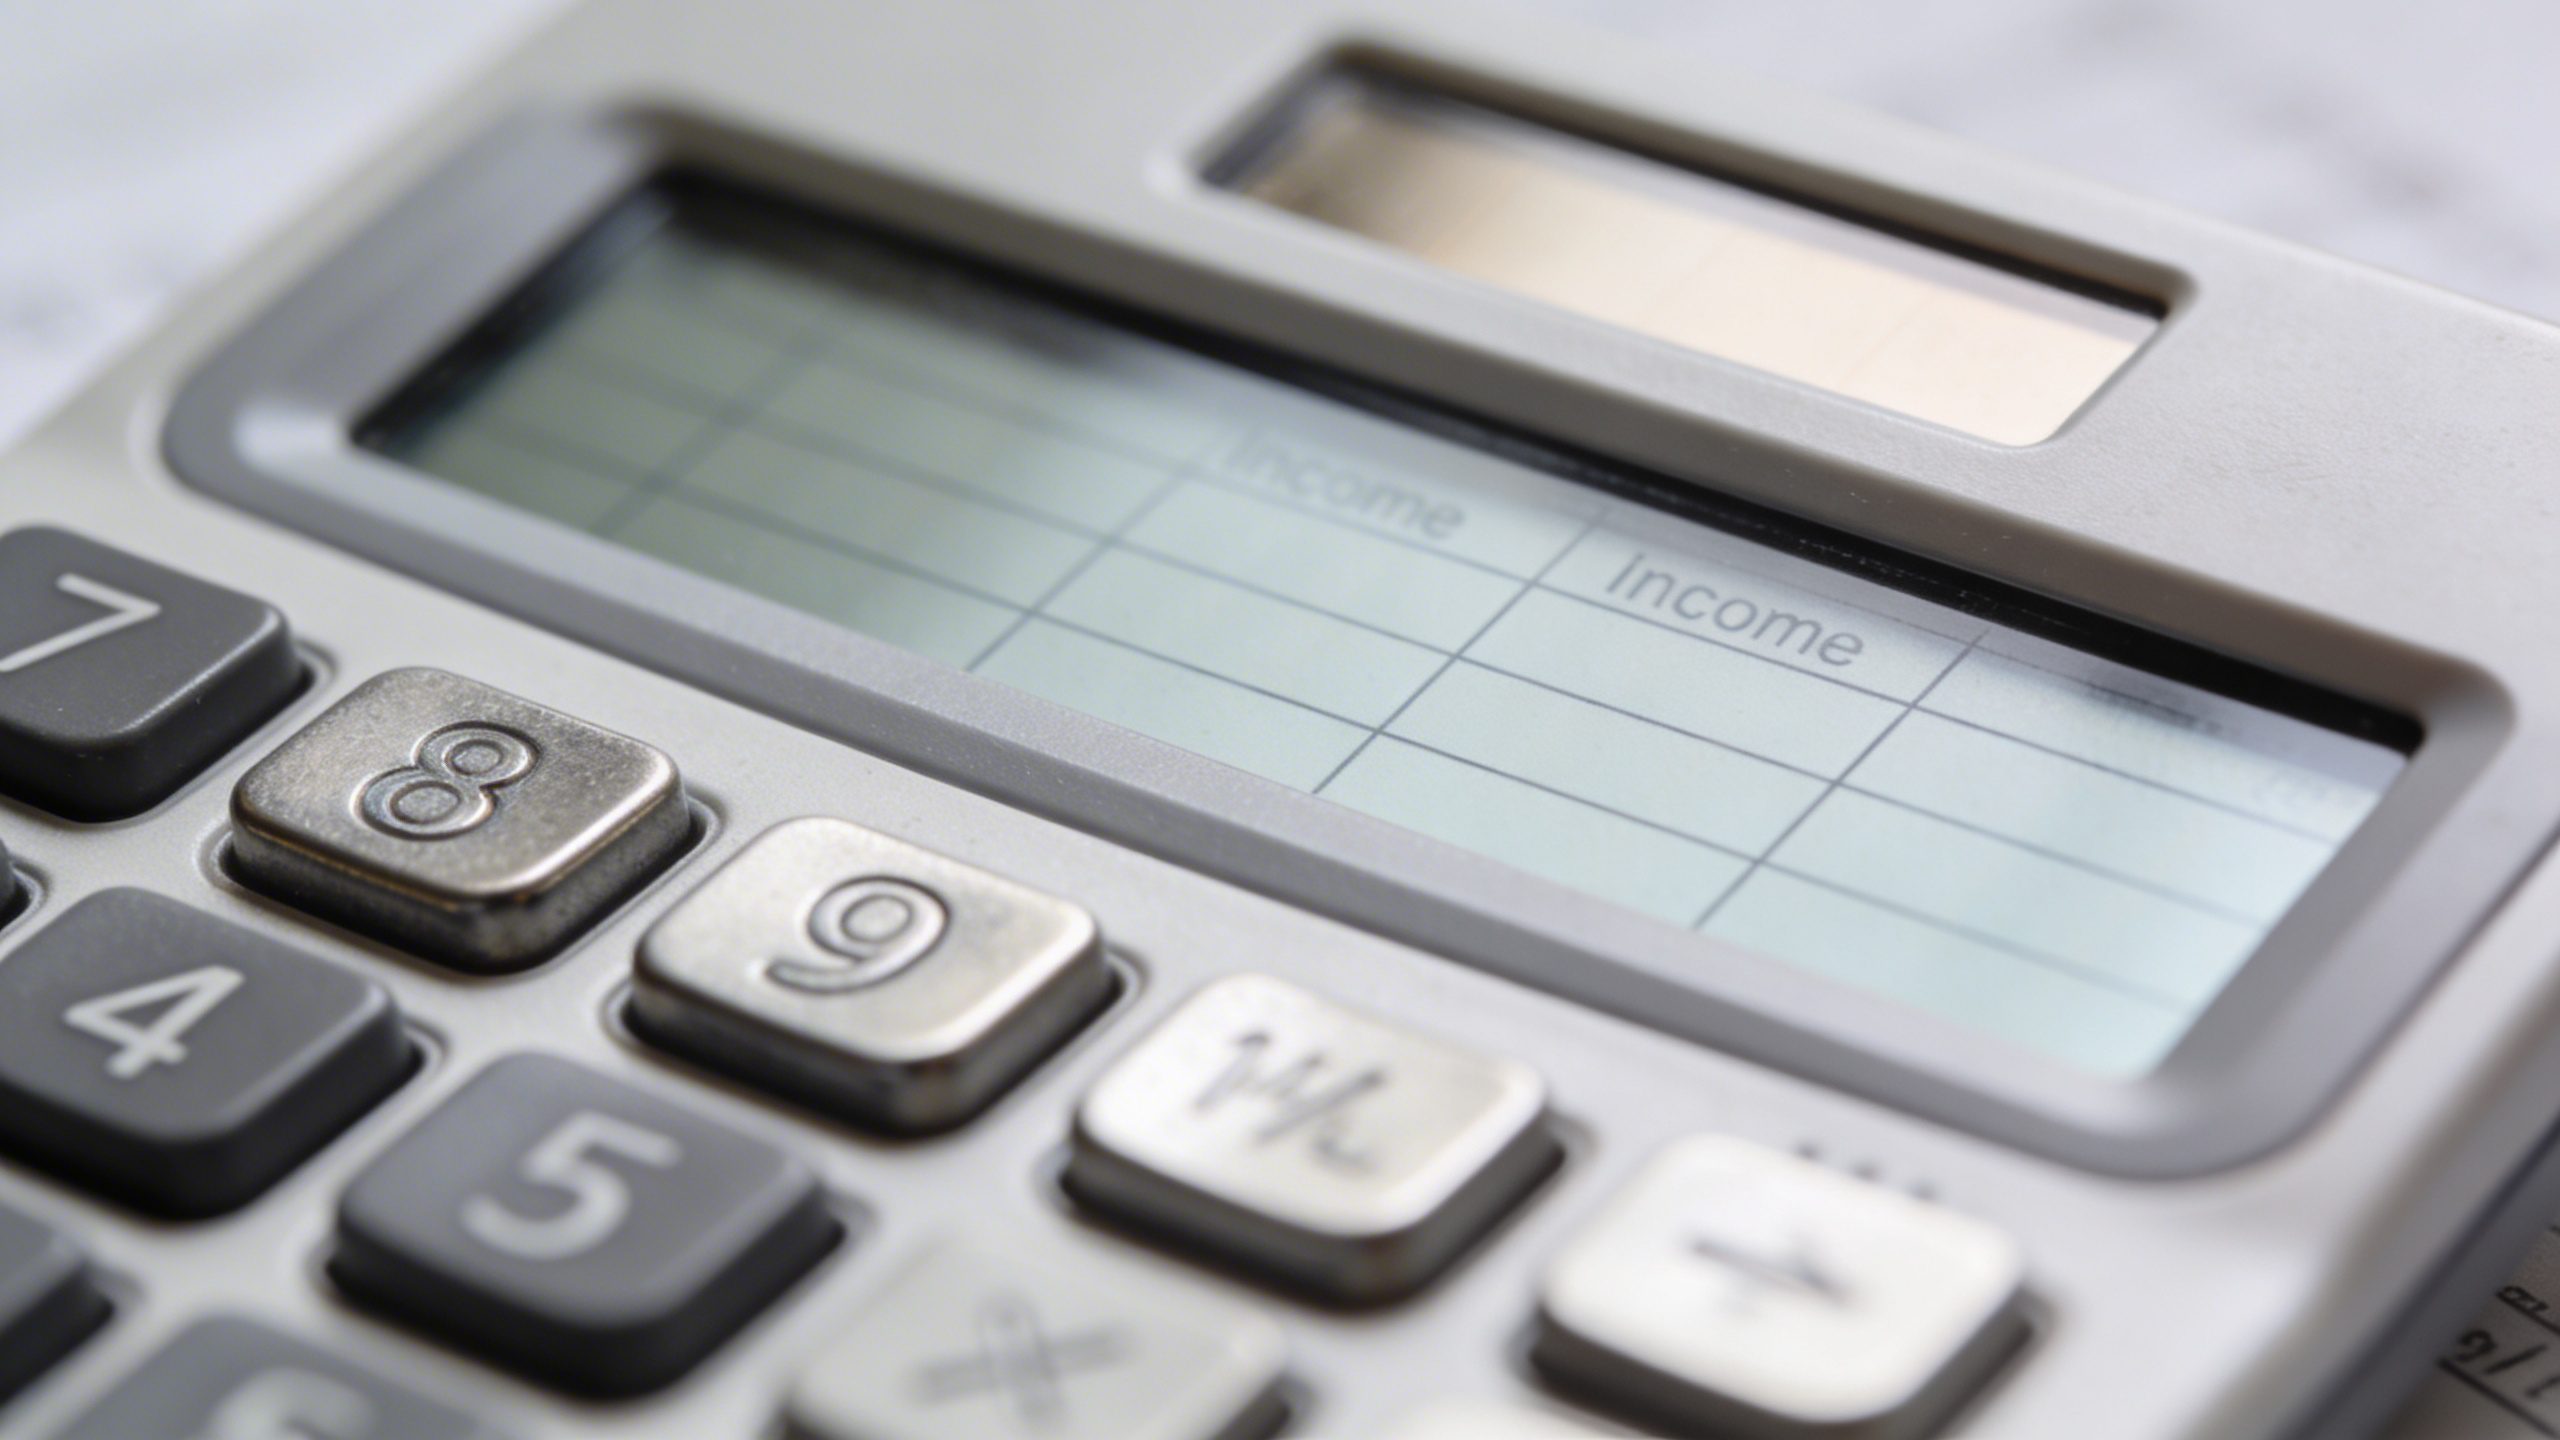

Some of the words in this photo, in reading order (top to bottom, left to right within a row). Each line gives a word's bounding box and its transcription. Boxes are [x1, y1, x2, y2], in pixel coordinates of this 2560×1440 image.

[0, 573, 162, 672] 7
[1604, 552, 1865, 667] Income
[350, 720, 542, 843] 8
[764, 873, 953, 997] 9
[64, 964, 246, 1079] 4
[461, 1110, 690, 1261] 5
